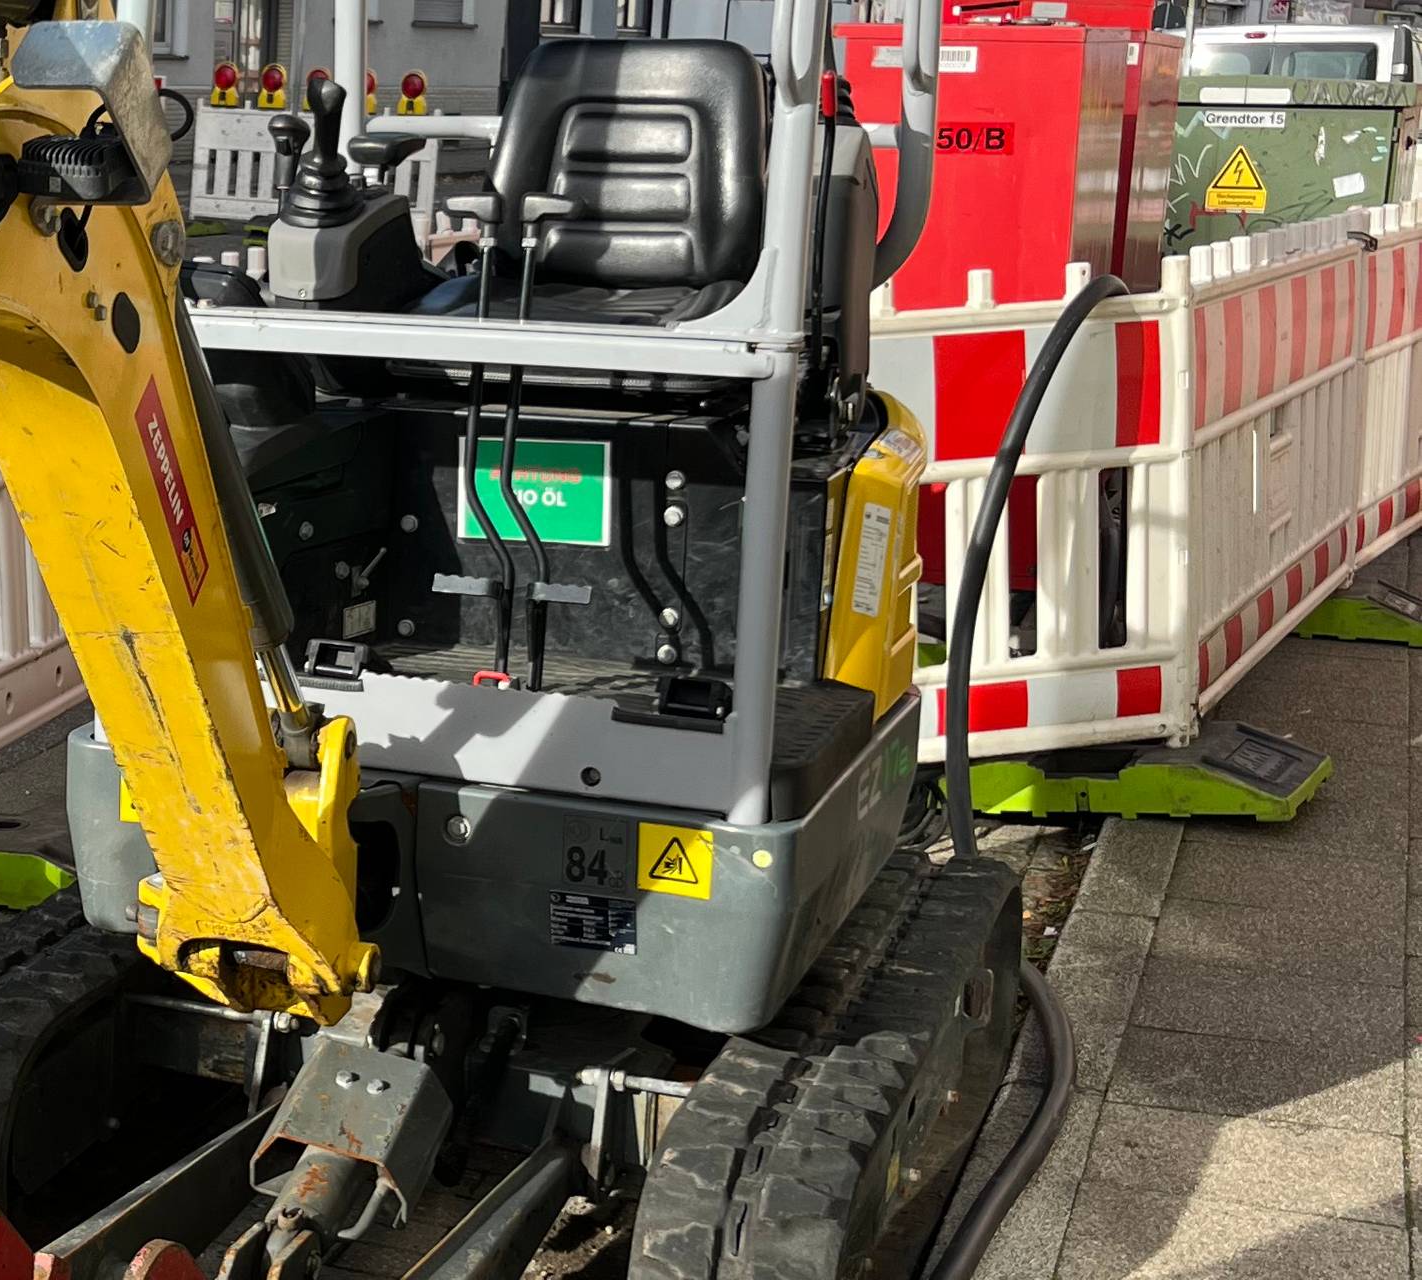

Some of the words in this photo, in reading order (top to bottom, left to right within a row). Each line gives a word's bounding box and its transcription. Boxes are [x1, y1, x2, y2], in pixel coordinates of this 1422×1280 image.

[1205, 112, 1265, 124] Grendtor
[1269, 112, 1284, 125] 15
[936, 127, 1006, 151] 50/B
[148, 412, 184, 525] ZEPPELIN
[489, 466, 581, 483] AHTUNG
[541, 487, 566, 507] ÖL
[565, 846, 609, 886] 84
